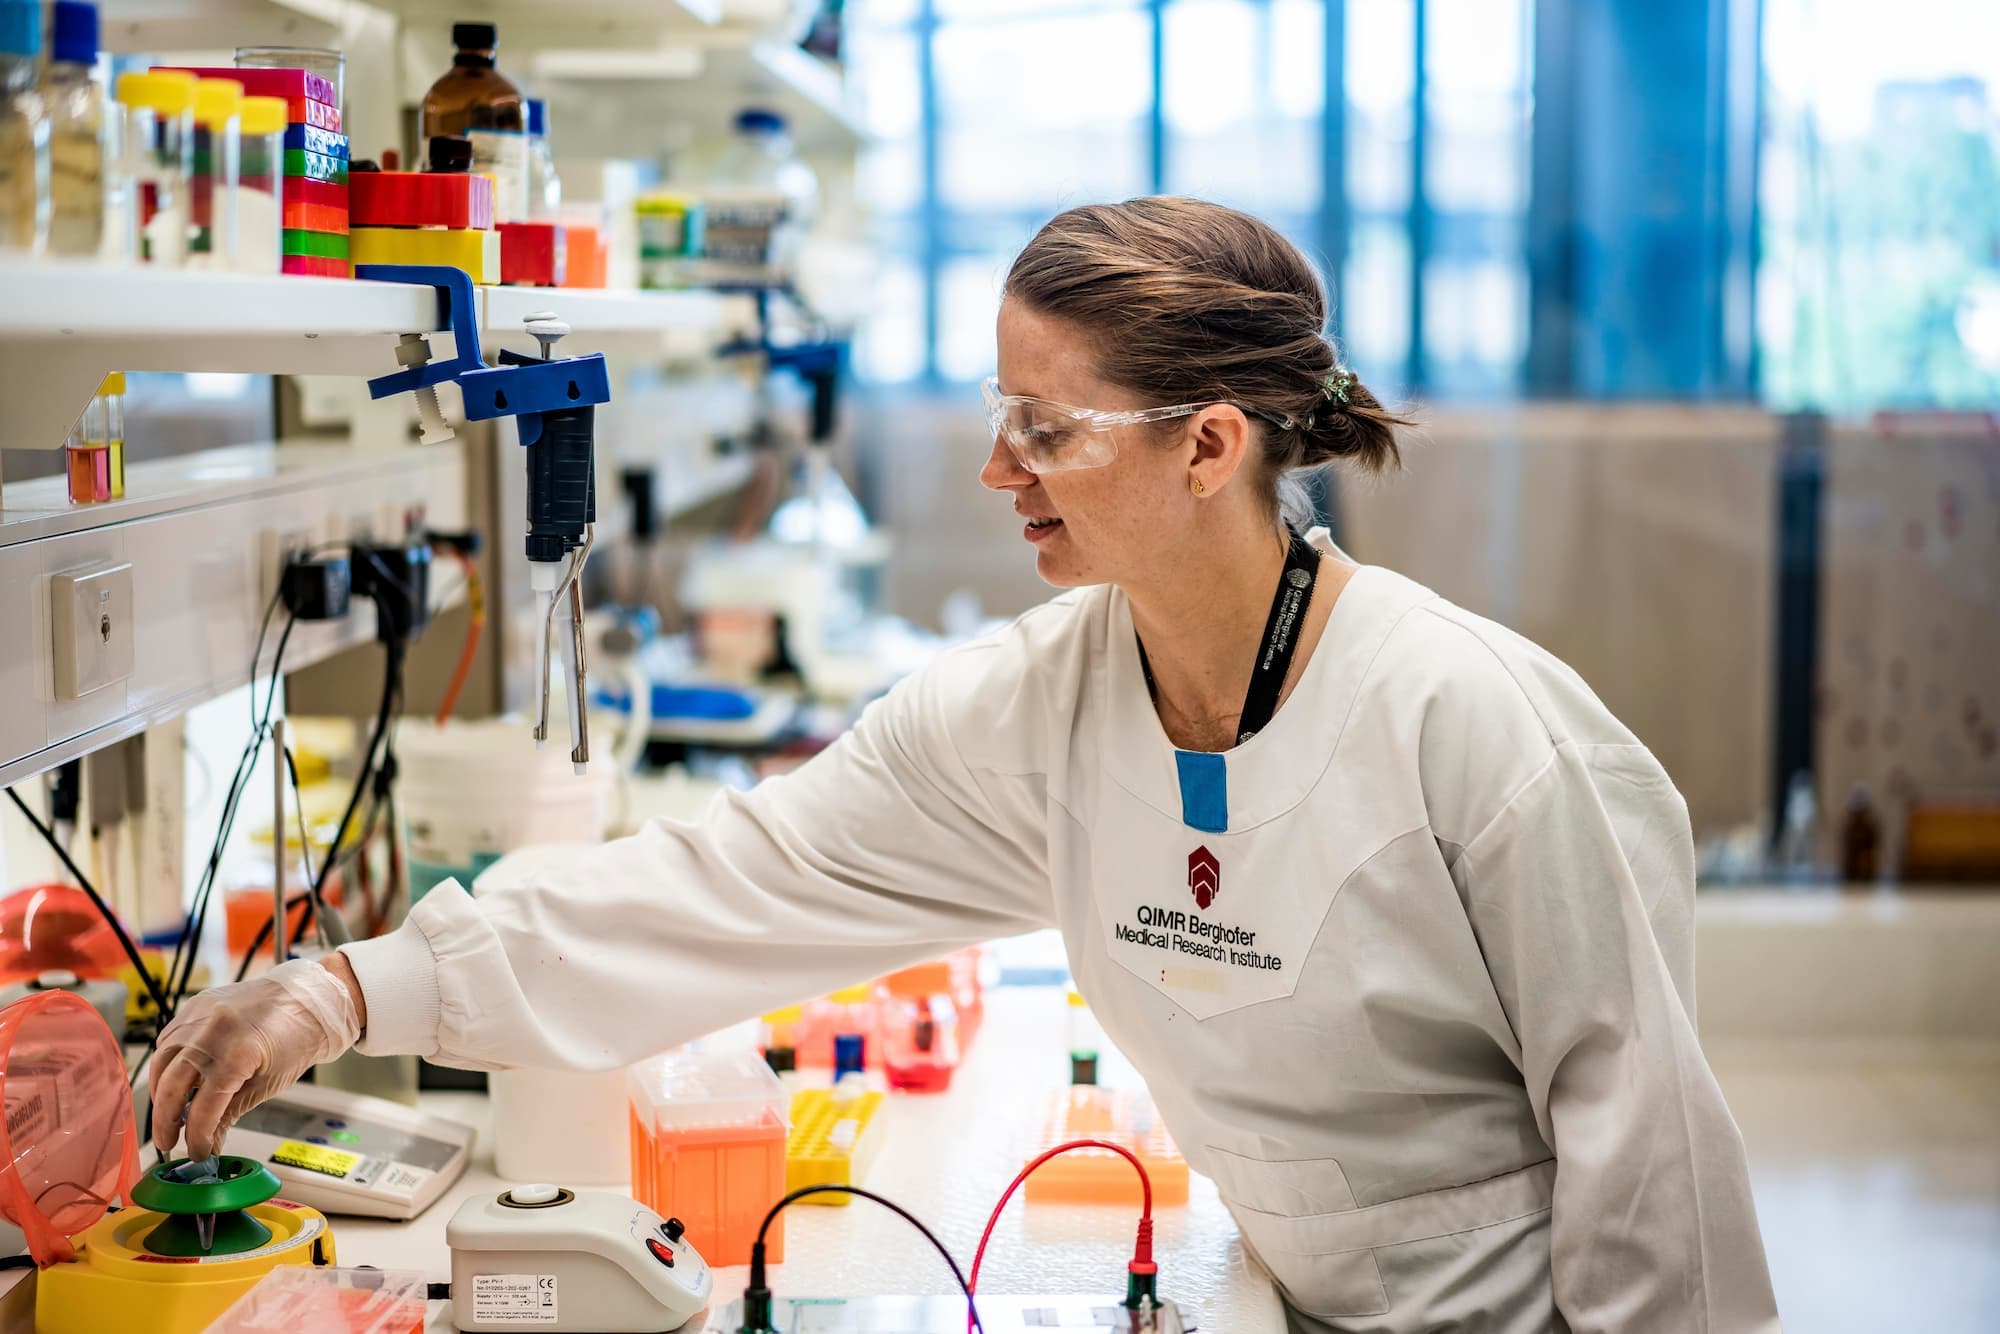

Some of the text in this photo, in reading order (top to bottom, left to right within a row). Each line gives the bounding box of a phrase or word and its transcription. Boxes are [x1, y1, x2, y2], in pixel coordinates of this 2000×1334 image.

[1115, 923, 1282, 971] Medical Research Institute
[1137, 905, 1256, 947] QIMR Berghofer
